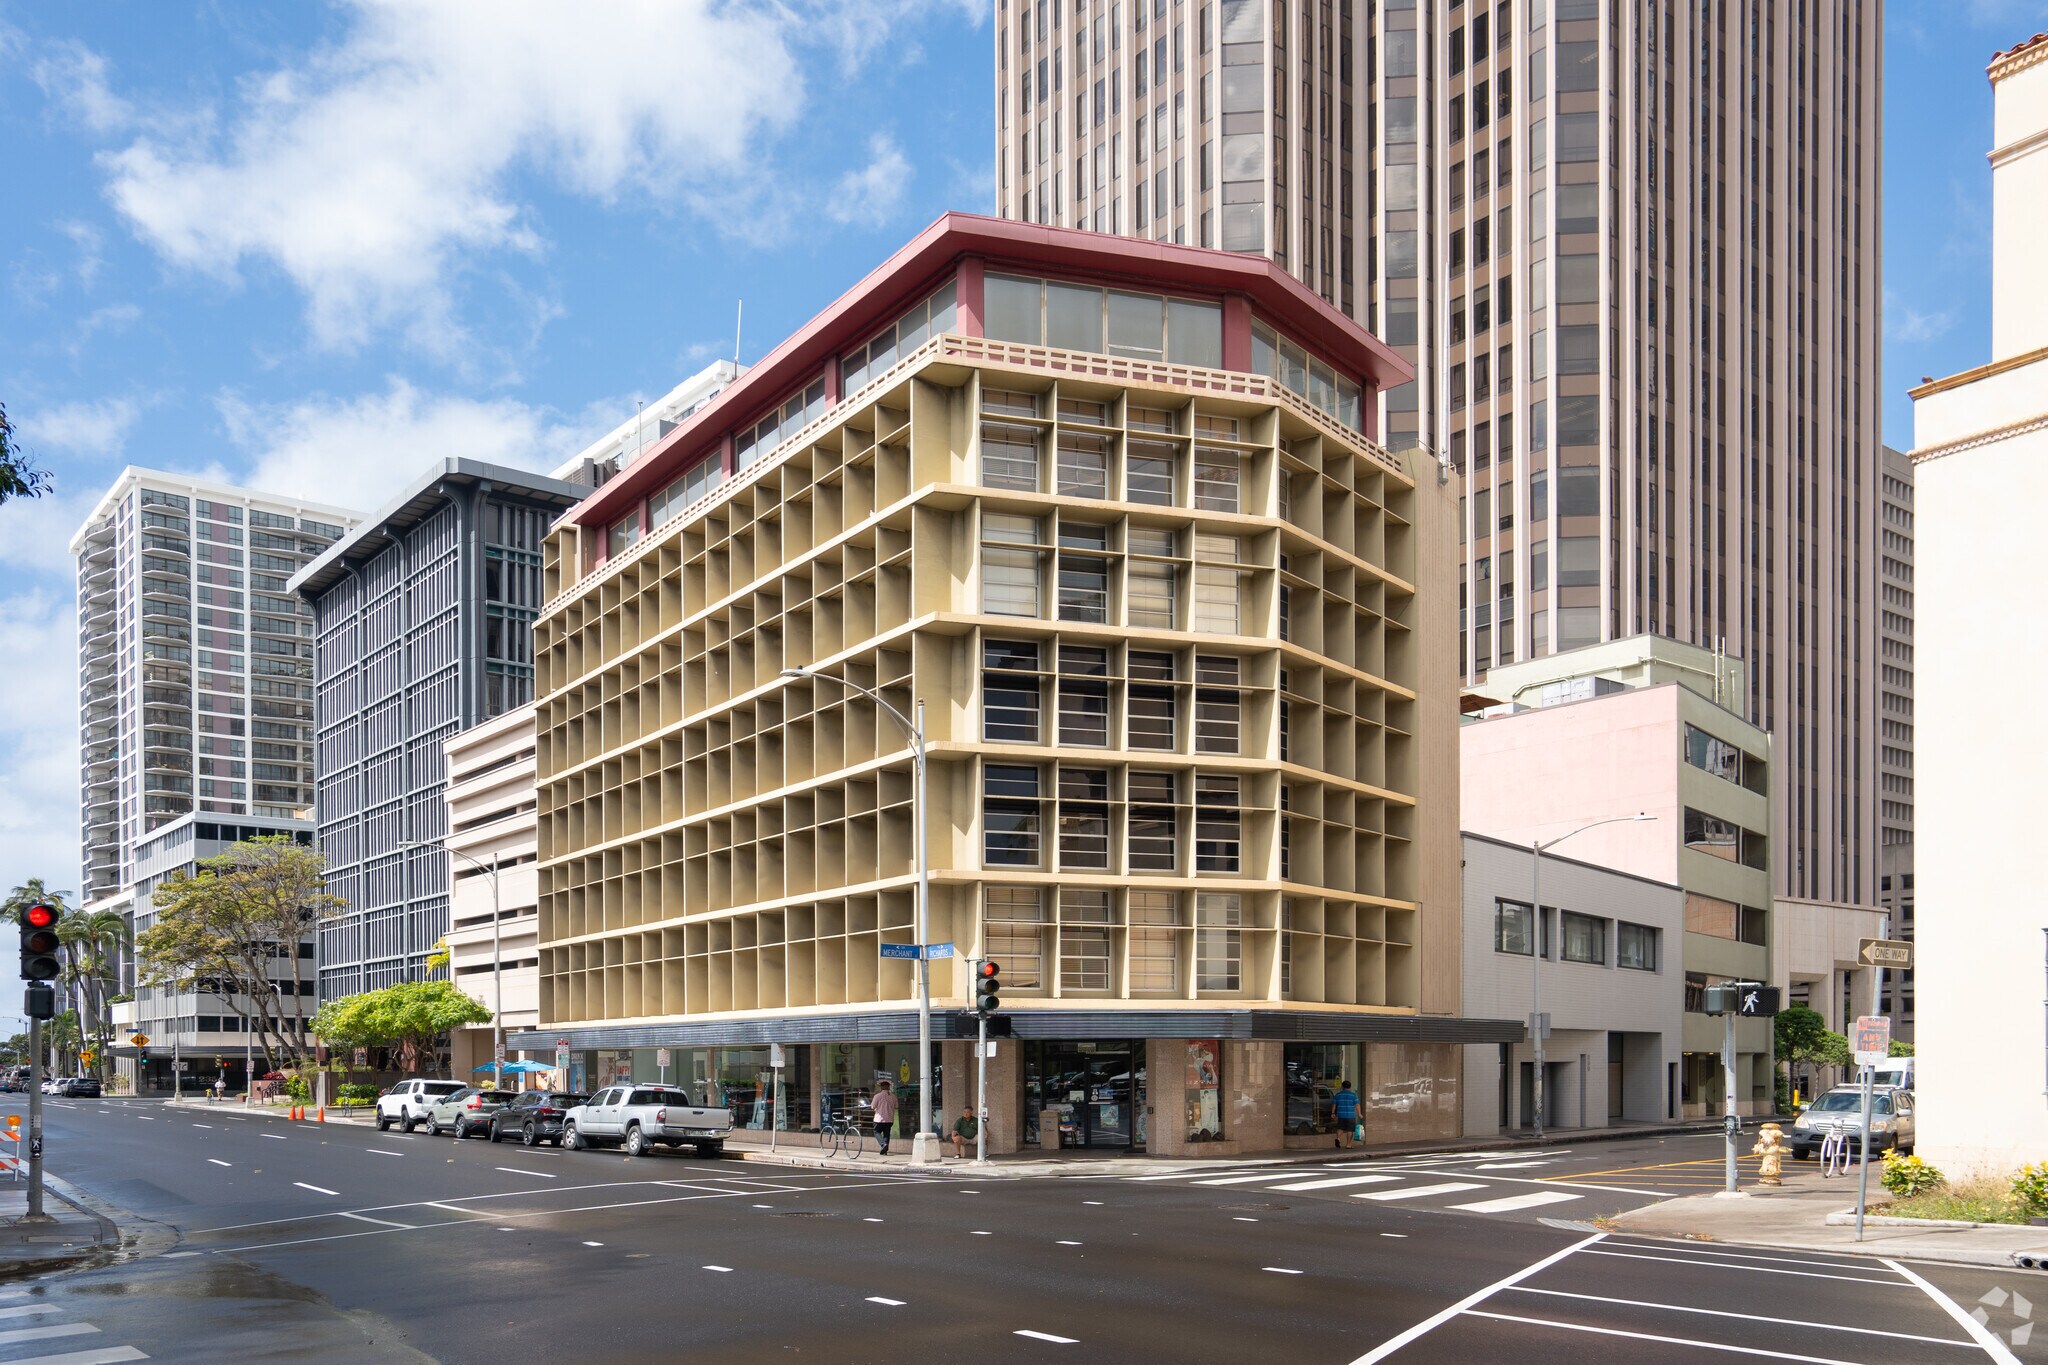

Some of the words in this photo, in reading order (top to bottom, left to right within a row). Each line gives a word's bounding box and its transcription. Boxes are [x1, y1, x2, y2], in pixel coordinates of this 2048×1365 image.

[883, 948, 913, 958] MERCHANT
[929, 948, 949, 958] RICHARDS
[1874, 948, 1890, 959] ONE
[1891, 949, 1907, 960] WAY
[1862, 1033, 1882, 1042] ANY
